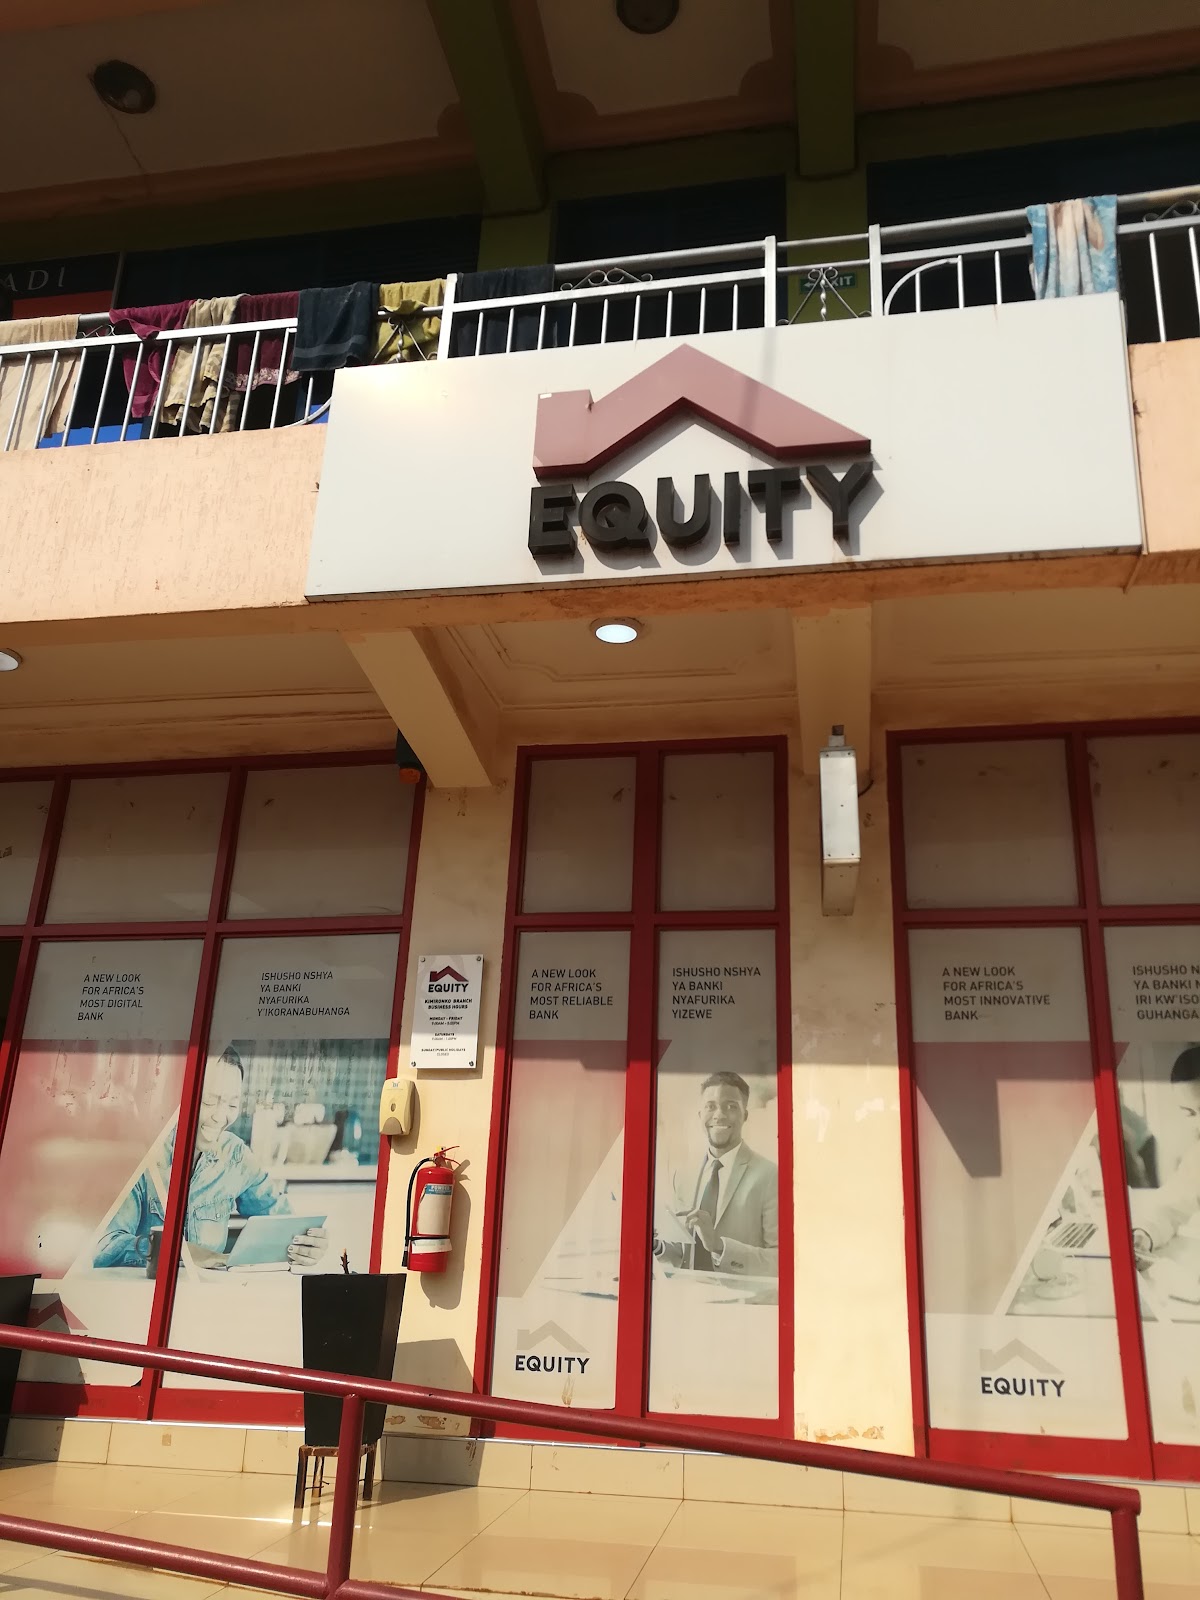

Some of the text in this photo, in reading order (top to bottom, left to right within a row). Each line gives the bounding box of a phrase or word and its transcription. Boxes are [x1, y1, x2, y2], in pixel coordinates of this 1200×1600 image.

[528, 461, 873, 560] EQUITY
[531, 969, 596, 978] A NEW LOOK
[672, 966, 761, 977] ISHUSHO NSHYA
[942, 966, 1015, 977] A NEW LOOK
[1133, 964, 1187, 976] ISHUSHO
[84, 974, 141, 982] A NEW LOOK
[261, 971, 333, 981] ISHUSHO NSHYA
[260, 984, 301, 992] YA BANKI
[428, 983, 469, 993] EQUITY
[531, 982, 602, 992] FOR AFRICA'S
[672, 981, 723, 991] YA BANKI
[943, 980, 1024, 991] FOR AFRICA'S
[1133, 979, 1149, 990] YA
[1153, 979, 1192, 990] BANKI
[82, 986, 144, 995] FOR AFRICA'S
[80, 999, 143, 1008] MOST DIGITAL
[258, 996, 310, 1005] NYAFURIKA
[530, 996, 613, 1006] MOST RELIABLE
[672, 995, 735, 1005] NYAFURIKA
[944, 994, 1051, 1006] MOST INNOVATIVE
[1135, 994, 1152, 1005] IRI
[77, 1012, 104, 1021] BANK
[257, 1007, 350, 1017] Y'IKORANABUHANGA
[529, 1010, 559, 1020] BANK
[672, 1009, 713, 1019] YIZEWE
[945, 1010, 979, 1020] BANK
[1137, 1009, 1200, 1020] GUHANGA
[515, 1354, 590, 1374] EQUITY
[981, 1376, 1065, 1398] EQUITY
